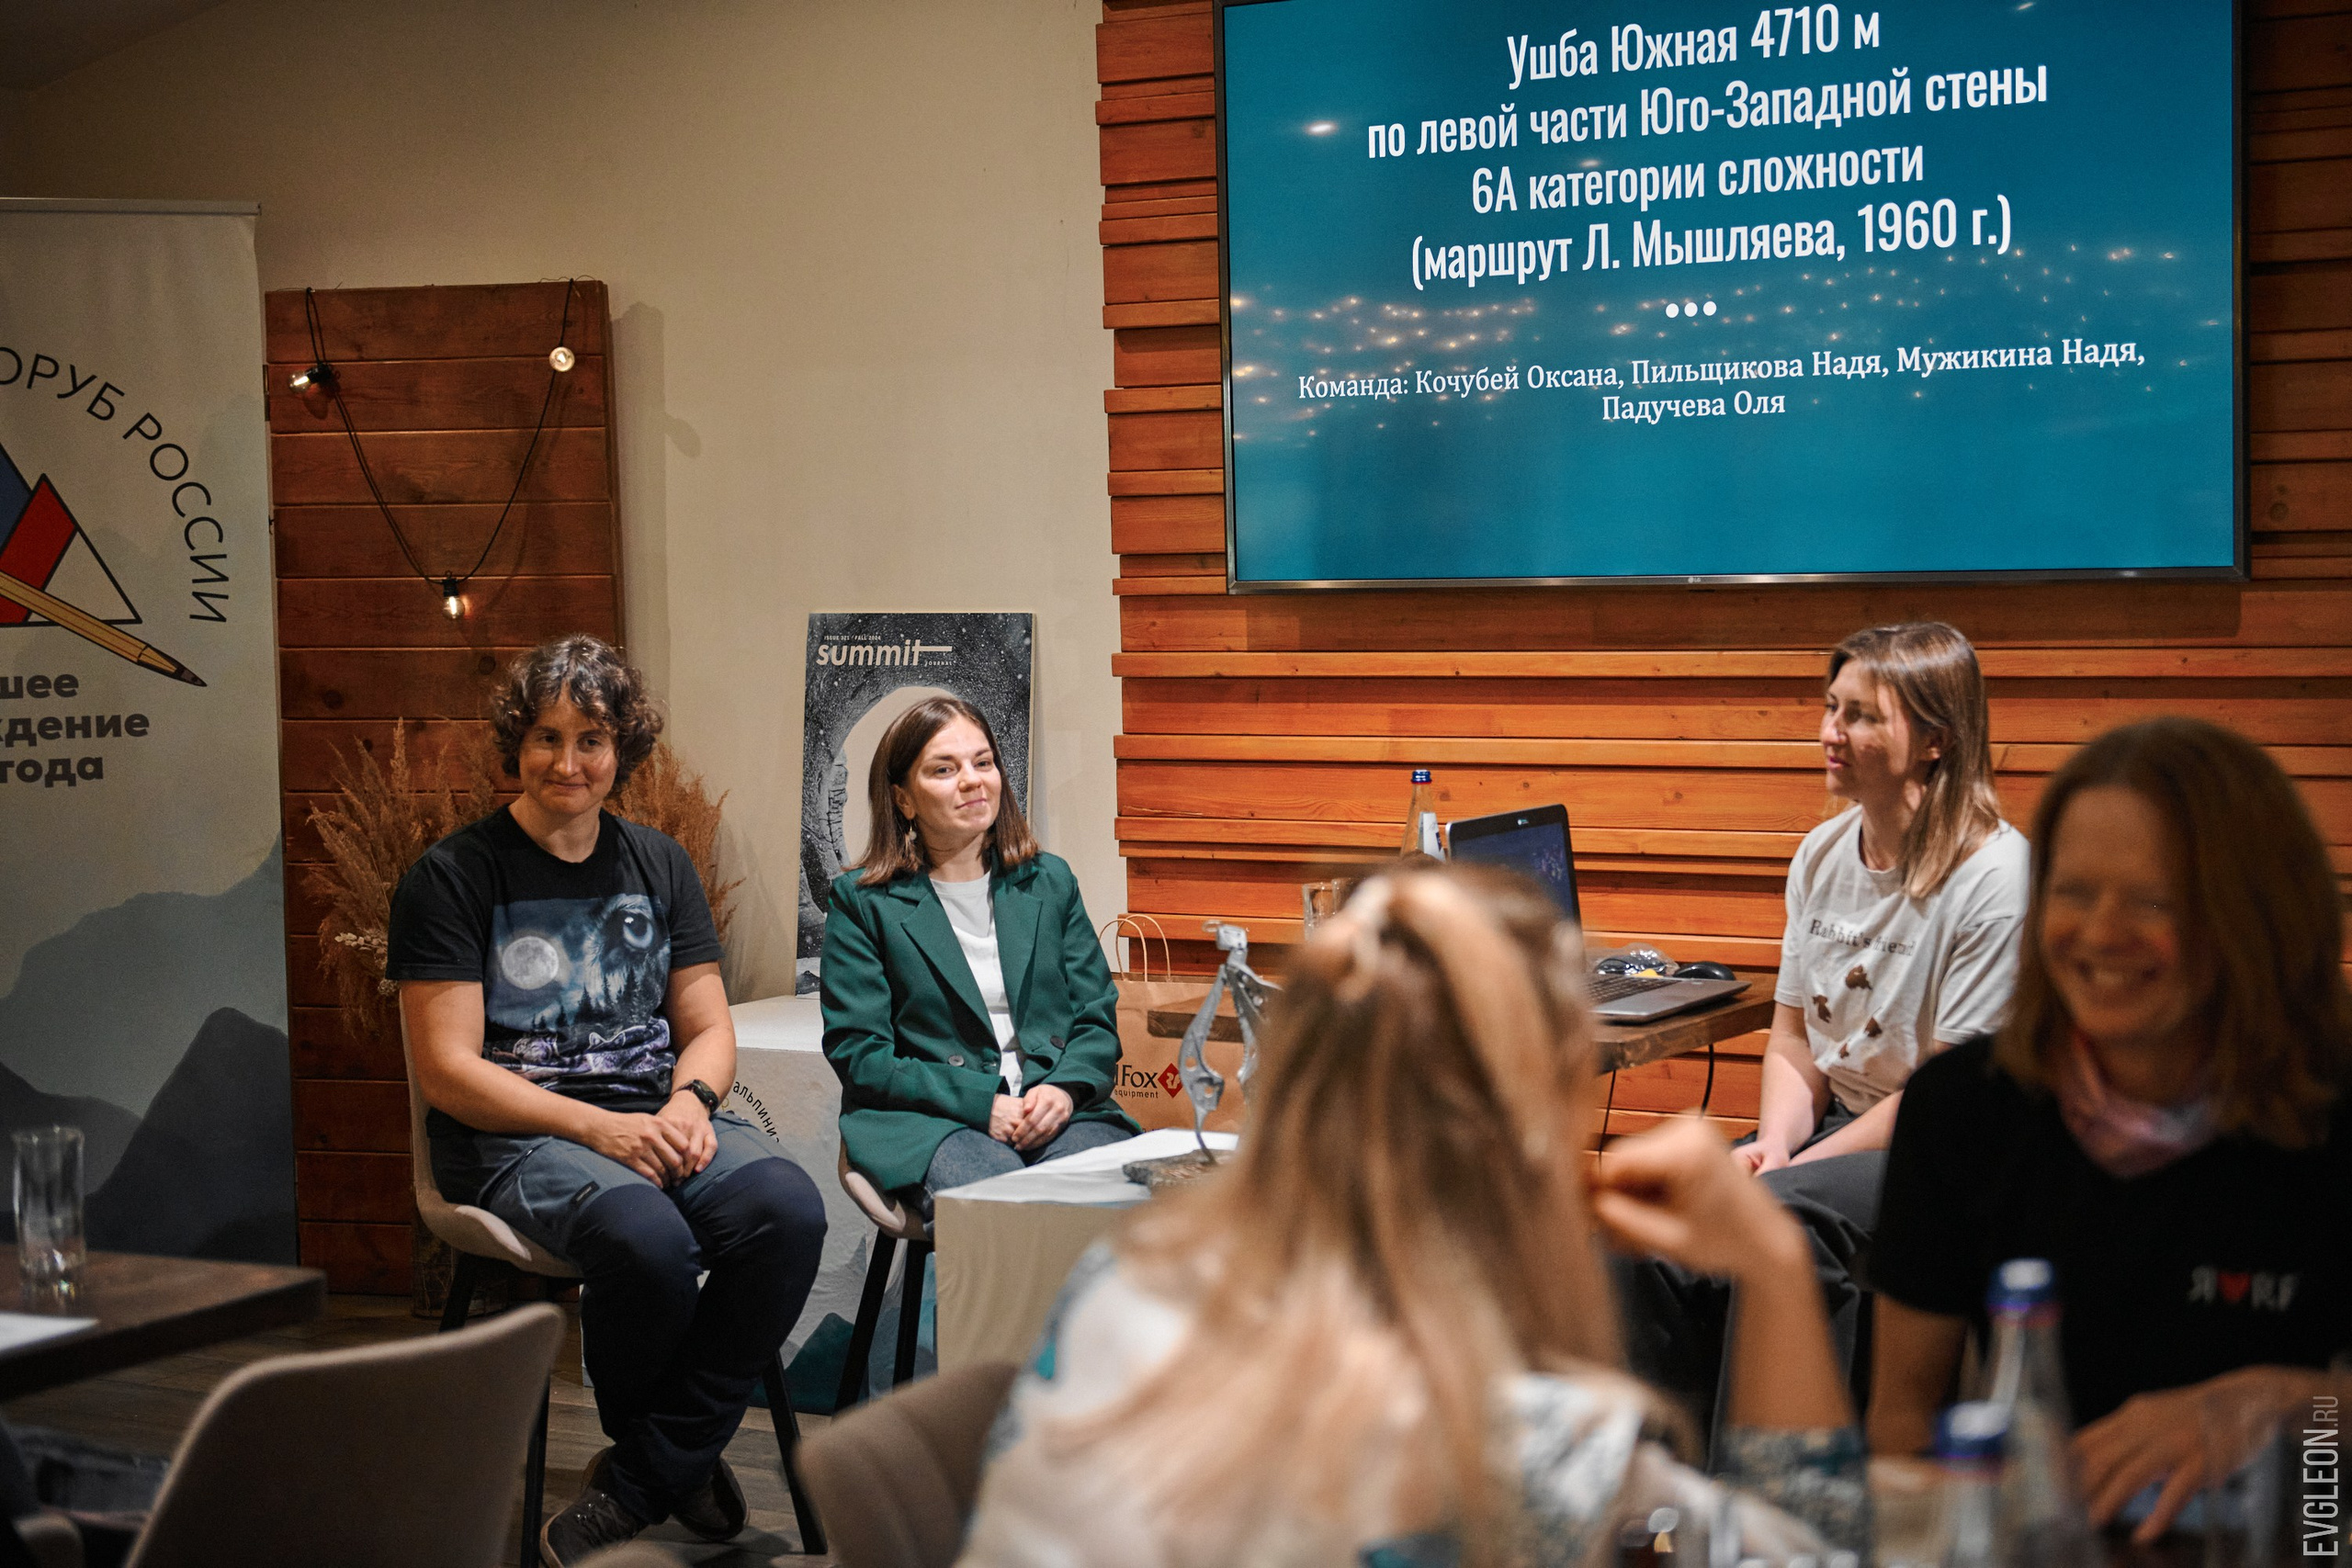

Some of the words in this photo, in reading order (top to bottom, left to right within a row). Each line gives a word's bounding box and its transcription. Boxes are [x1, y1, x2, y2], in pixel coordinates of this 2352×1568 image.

[1507, 28, 1599, 90] Ушба
[1611, 23, 1737, 73] Южная
[1750, 3, 1839, 59] 4710
[1854, 12, 1880, 50] м
[1368, 123, 1406, 159] по
[1417, 102, 1518, 155] левой
[1530, 103, 1627, 144] части
[1641, 66, 1911, 136] Юго-Западной
[1926, 65, 2047, 111] стены
[1472, 165, 1518, 214] 6А
[1529, 160, 1705, 212] категории
[1718, 145, 1923, 196] сложности
[1412, 235, 1573, 291] (маршрут
[1582, 222, 1620, 271] Л.
[1633, 219, 1846, 267] Мышляева,
[1857, 198, 1957, 253] 1960
[1972, 194, 2011, 255] г.)
[1297, 374, 1409, 400] Команда:
[1415, 365, 1521, 396] Кочубей
[1527, 365, 1624, 389] Оксана,
[1631, 358, 1804, 386] Пильщикова
[1812, 351, 1889, 380] Надя,
[1896, 346, 2053, 378] Мужикина
[2061, 338, 2145, 368] Надя,
[1601, 396, 1726, 425] Падучева
[1734, 389, 1786, 415] Оля
[122, 412, 229, 622] РОССИИ
[816, 639, 953, 666] summit
[0, 713, 150, 748] дение
